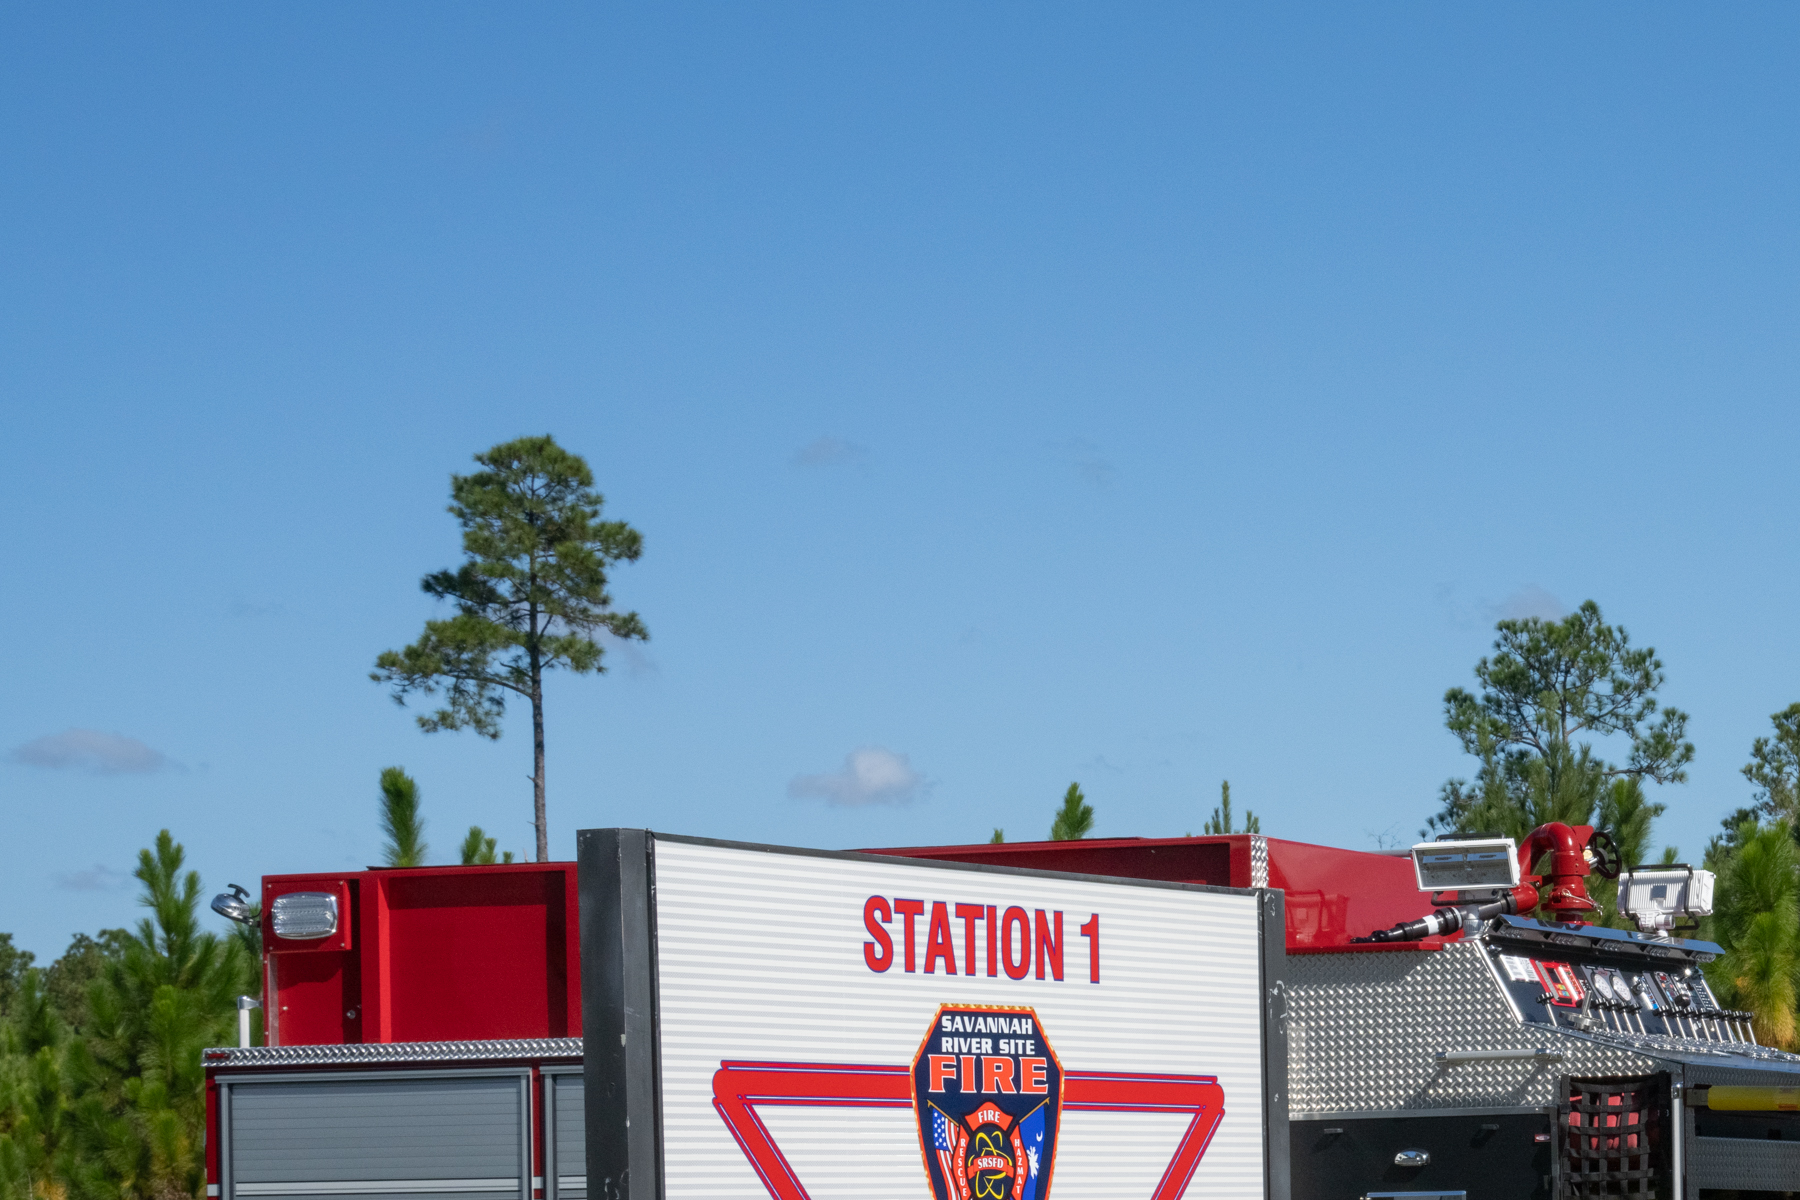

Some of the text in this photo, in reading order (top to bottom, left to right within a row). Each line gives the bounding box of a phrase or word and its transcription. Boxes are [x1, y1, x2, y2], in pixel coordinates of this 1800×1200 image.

[863, 895, 1101, 984] STATION 1
[941, 1015, 1033, 1035] SAVANNAH
[941, 1037, 1036, 1055] RIVER SITE
[928, 1055, 1049, 1094] FIRE
[977, 1110, 1001, 1123] FIRE
[957, 1138, 968, 1197] RESCUE
[977, 1157, 1004, 1169] SRSFD
[1014, 1139, 1024, 1194] HAZMAT
